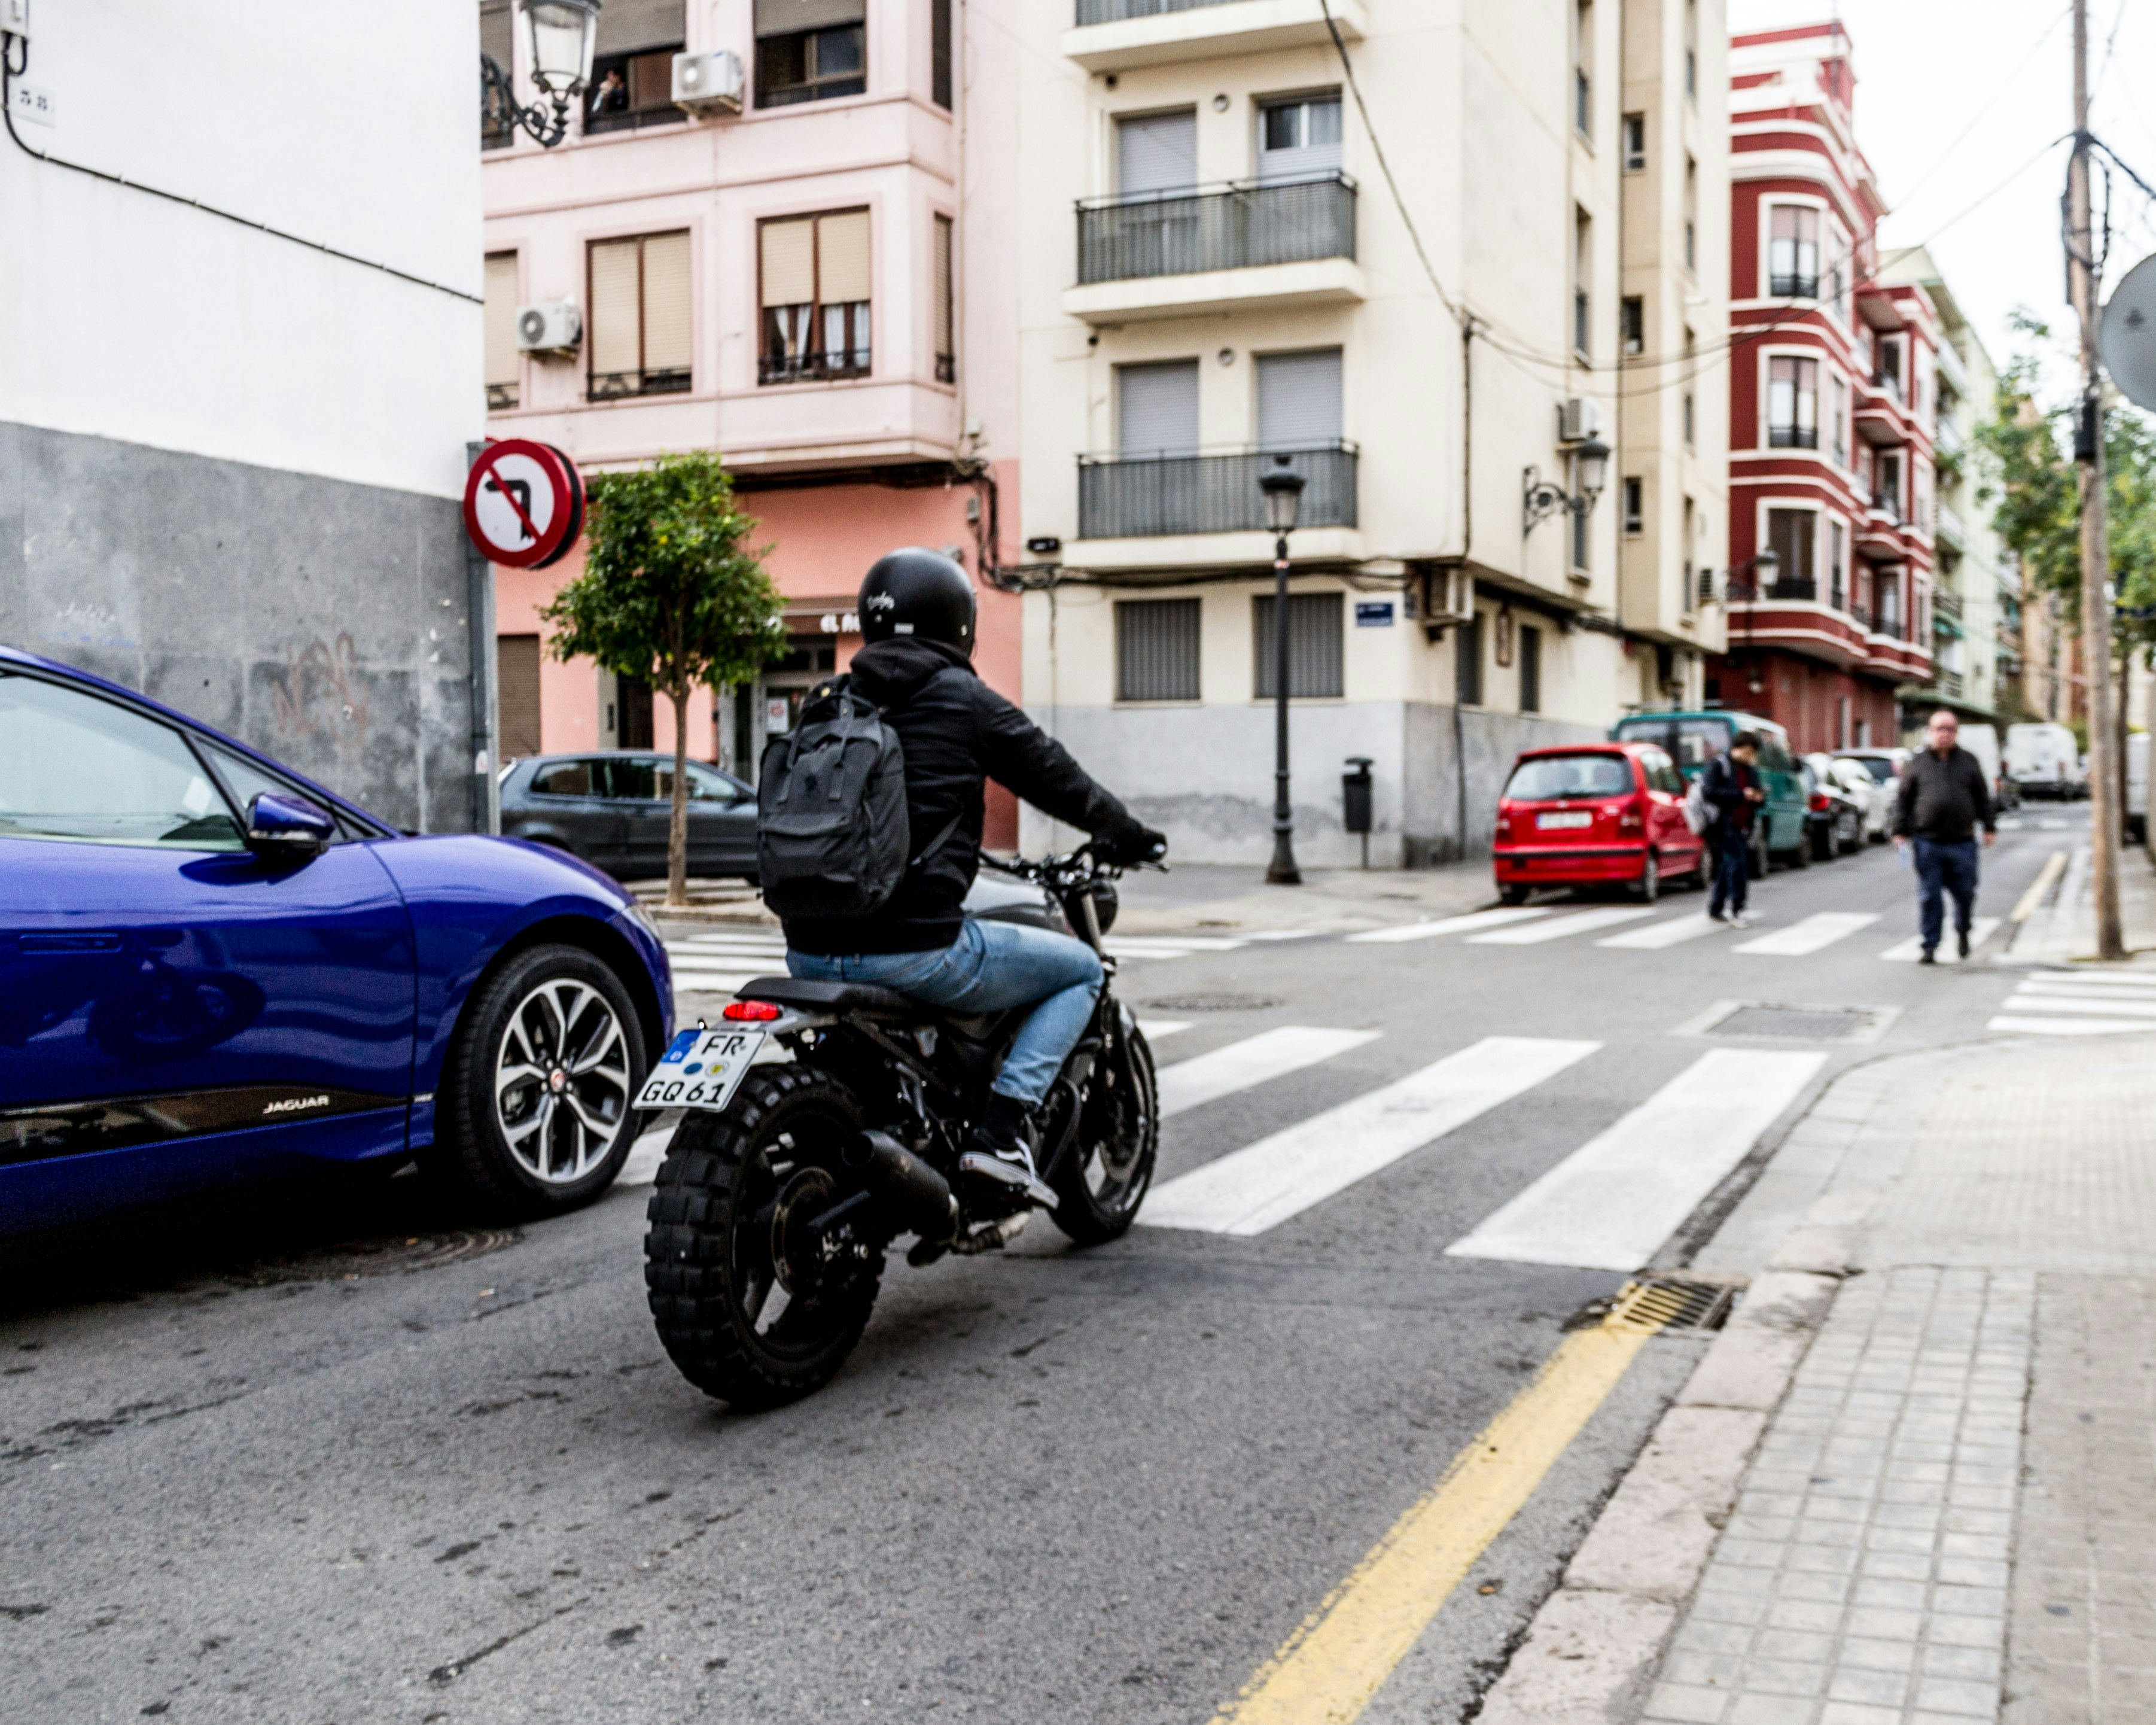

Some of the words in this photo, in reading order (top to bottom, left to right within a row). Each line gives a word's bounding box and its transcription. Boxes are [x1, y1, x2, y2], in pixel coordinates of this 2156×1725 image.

[701, 1035, 745, 1056] FR
[641, 1080, 685, 1102] GQ
[686, 1081, 725, 1103] 61
[262, 1094, 330, 1114] JAGUAR
